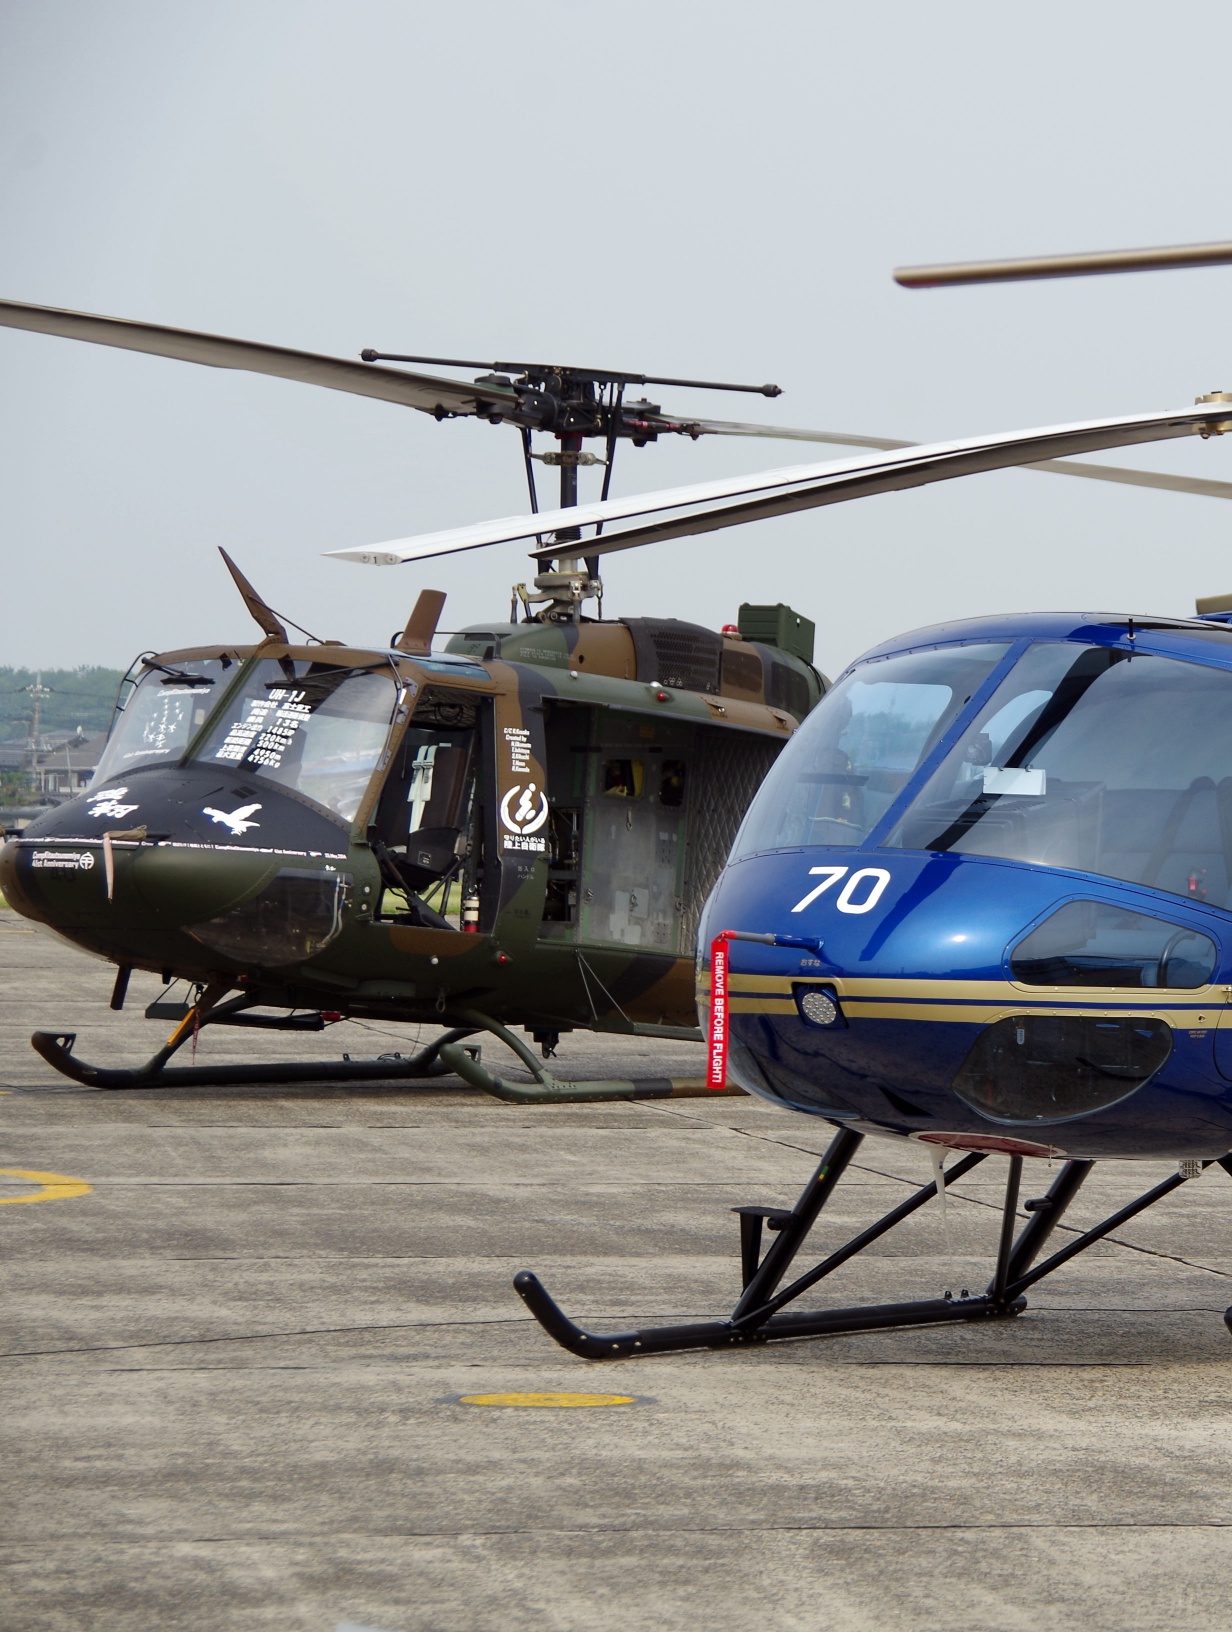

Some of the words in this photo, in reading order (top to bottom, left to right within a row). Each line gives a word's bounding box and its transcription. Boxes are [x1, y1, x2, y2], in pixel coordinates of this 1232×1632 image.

[268, 689, 306, 702] UH-1J
[503, 834, 546, 843] 守りたい人がいる
[503, 840, 546, 852] 陸上自衛隊
[43, 859, 80, 869] Anniversary
[791, 866, 891, 914] 70
[714, 951, 725, 996] REMOVE
[713, 998, 725, 1041] BEFORE
[711, 1043, 724, 1084] FLIGHT!
